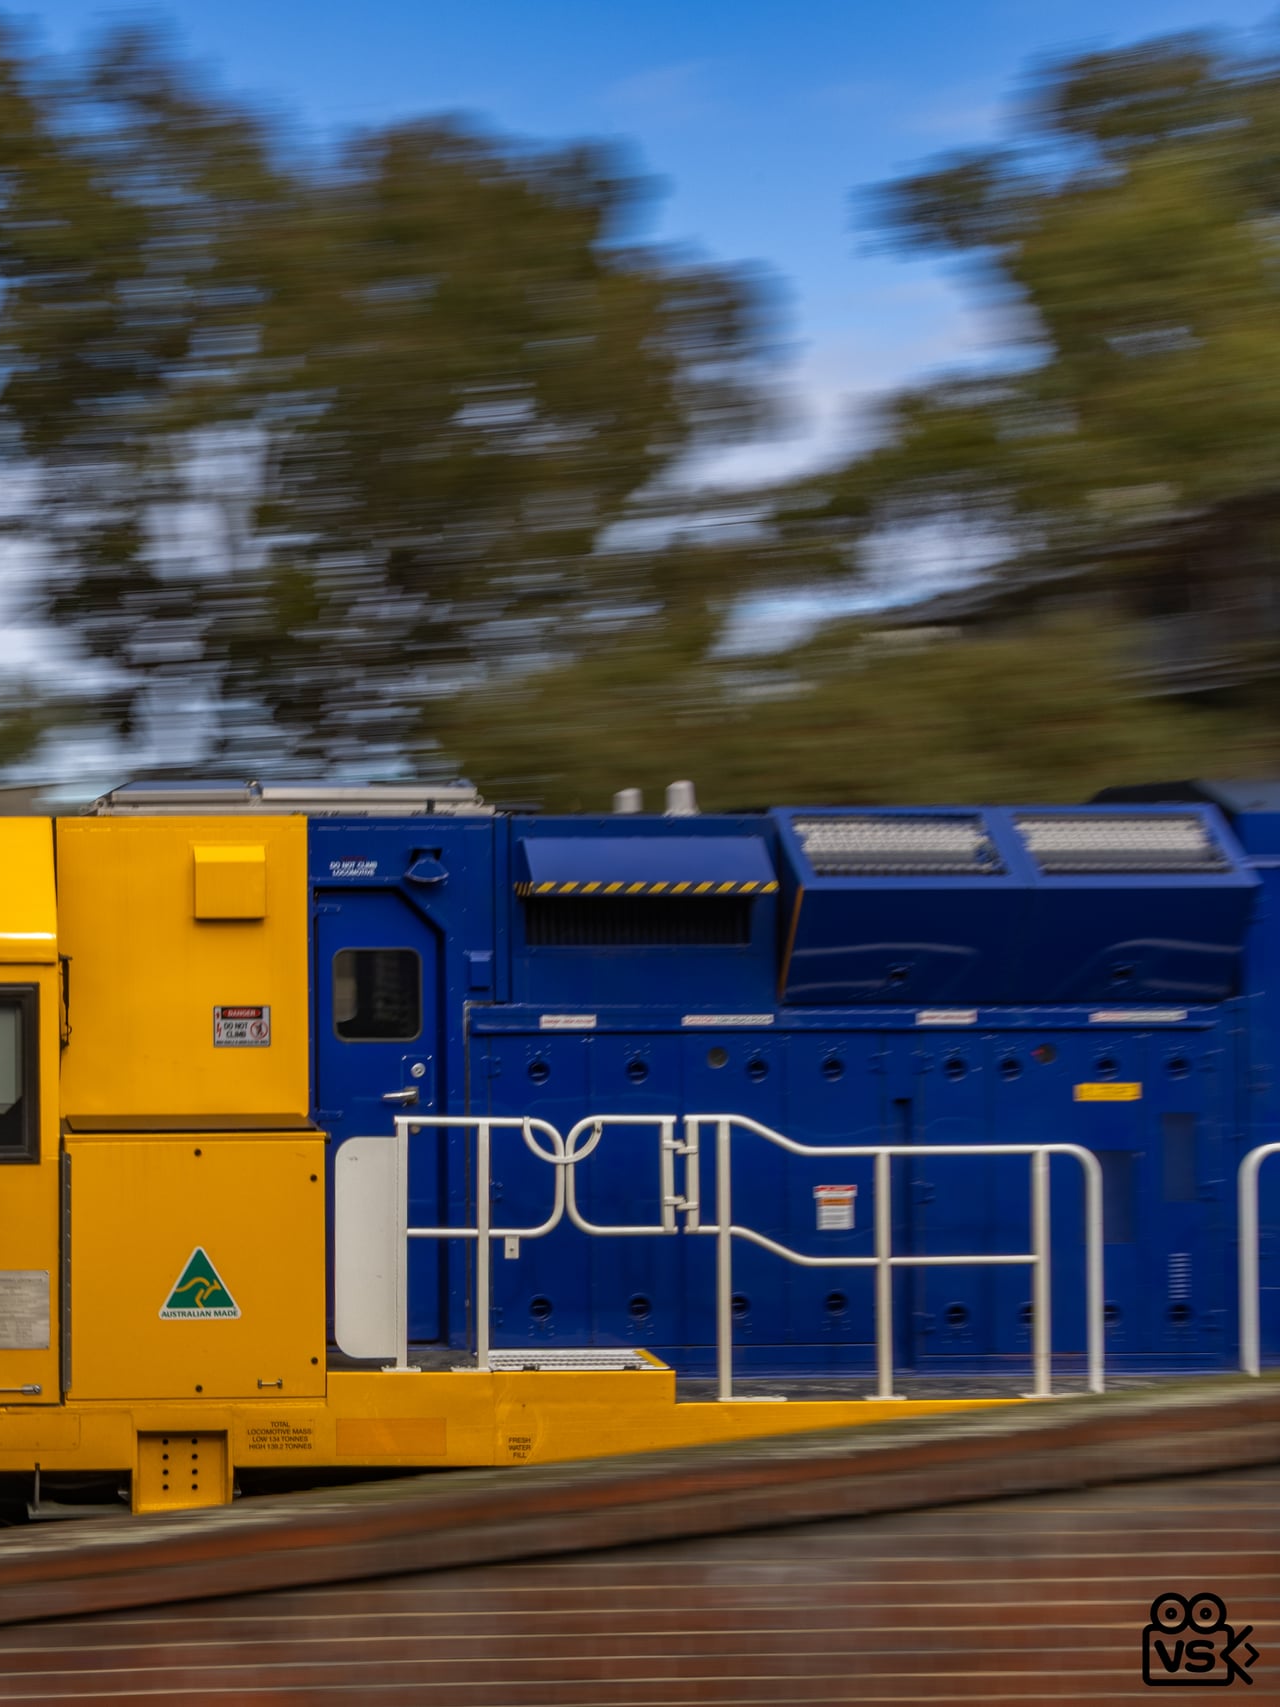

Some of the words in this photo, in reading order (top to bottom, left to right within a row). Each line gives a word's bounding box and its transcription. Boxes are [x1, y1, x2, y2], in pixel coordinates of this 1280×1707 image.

[329, 860, 341, 870] DO
[342, 860, 355, 870] NOT
[357, 860, 378, 870] CLIMB
[332, 869, 375, 877] LOCOMOTIVE
[227, 1009, 256, 1017] DANGER
[223, 1022, 233, 1030] DO
[235, 1022, 248, 1030] NOT
[162, 1310, 211, 1318] AUSTRALIAN
